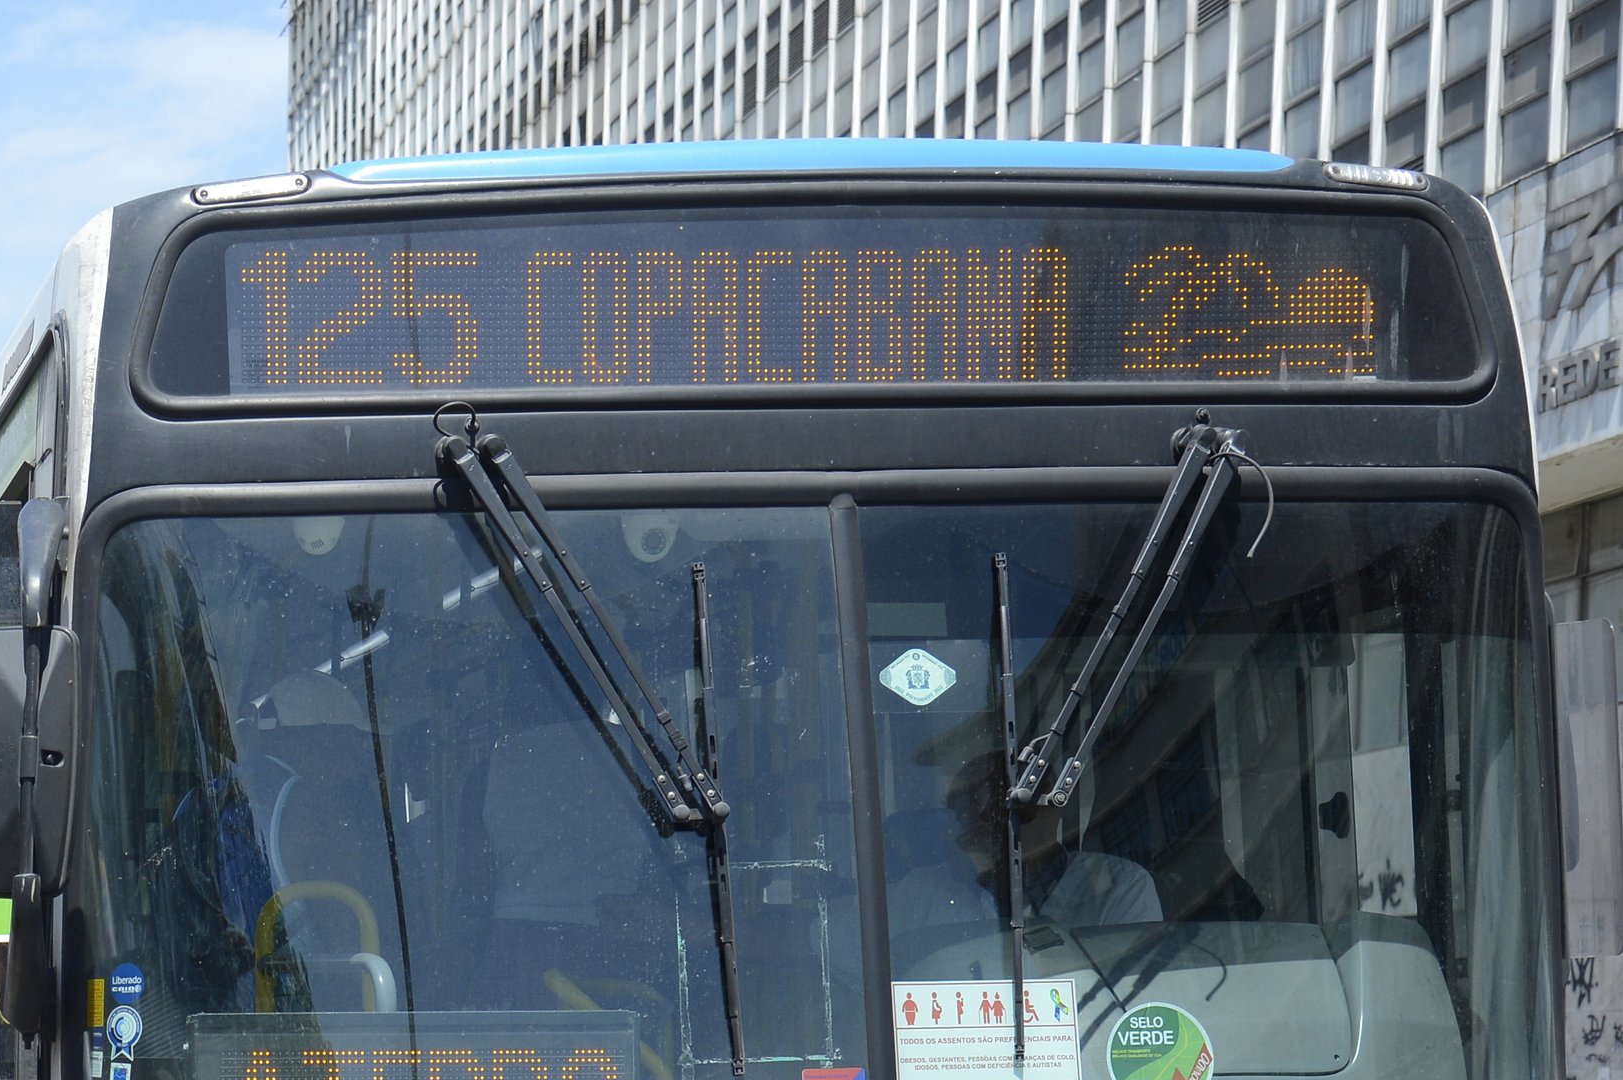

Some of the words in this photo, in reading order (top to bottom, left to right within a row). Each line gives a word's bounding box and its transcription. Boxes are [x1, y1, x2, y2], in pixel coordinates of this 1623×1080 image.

[241, 251, 478, 384] 125
[528, 248, 1069, 384] COPACABANA
[1538, 338, 1621, 414] REDE
[112, 976, 142, 985] Liberado
[1129, 1016, 1164, 1029] SELO
[938, 1036, 976, 1044] ASSENTOS
[977, 1035, 993, 1043] SÃO
[1118, 1030, 1175, 1046] VERDE
